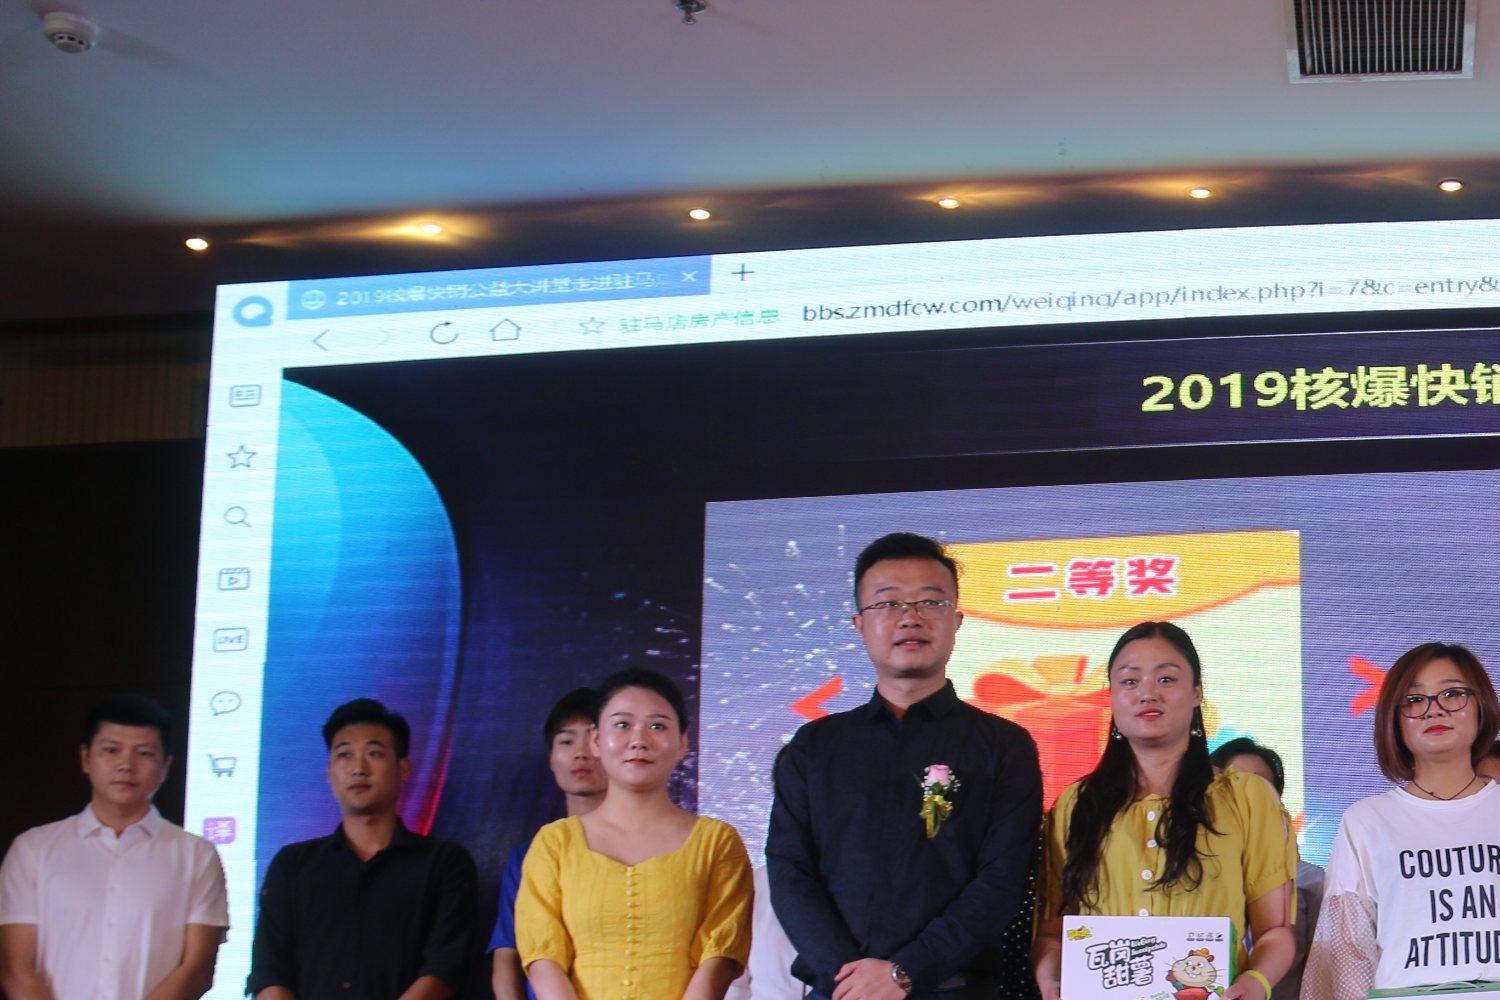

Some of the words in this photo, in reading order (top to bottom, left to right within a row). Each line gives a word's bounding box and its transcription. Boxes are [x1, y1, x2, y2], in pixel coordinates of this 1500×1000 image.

[618, 308, 781, 333] 驻马店房产信息
[1005, 556, 1179, 602] 二等奖
[1429, 888, 1454, 924] IS
[1461, 884, 1497, 919] AN
[1086, 939, 1131, 970] 瓦岗
[1102, 955, 1154, 989] 甜薯
